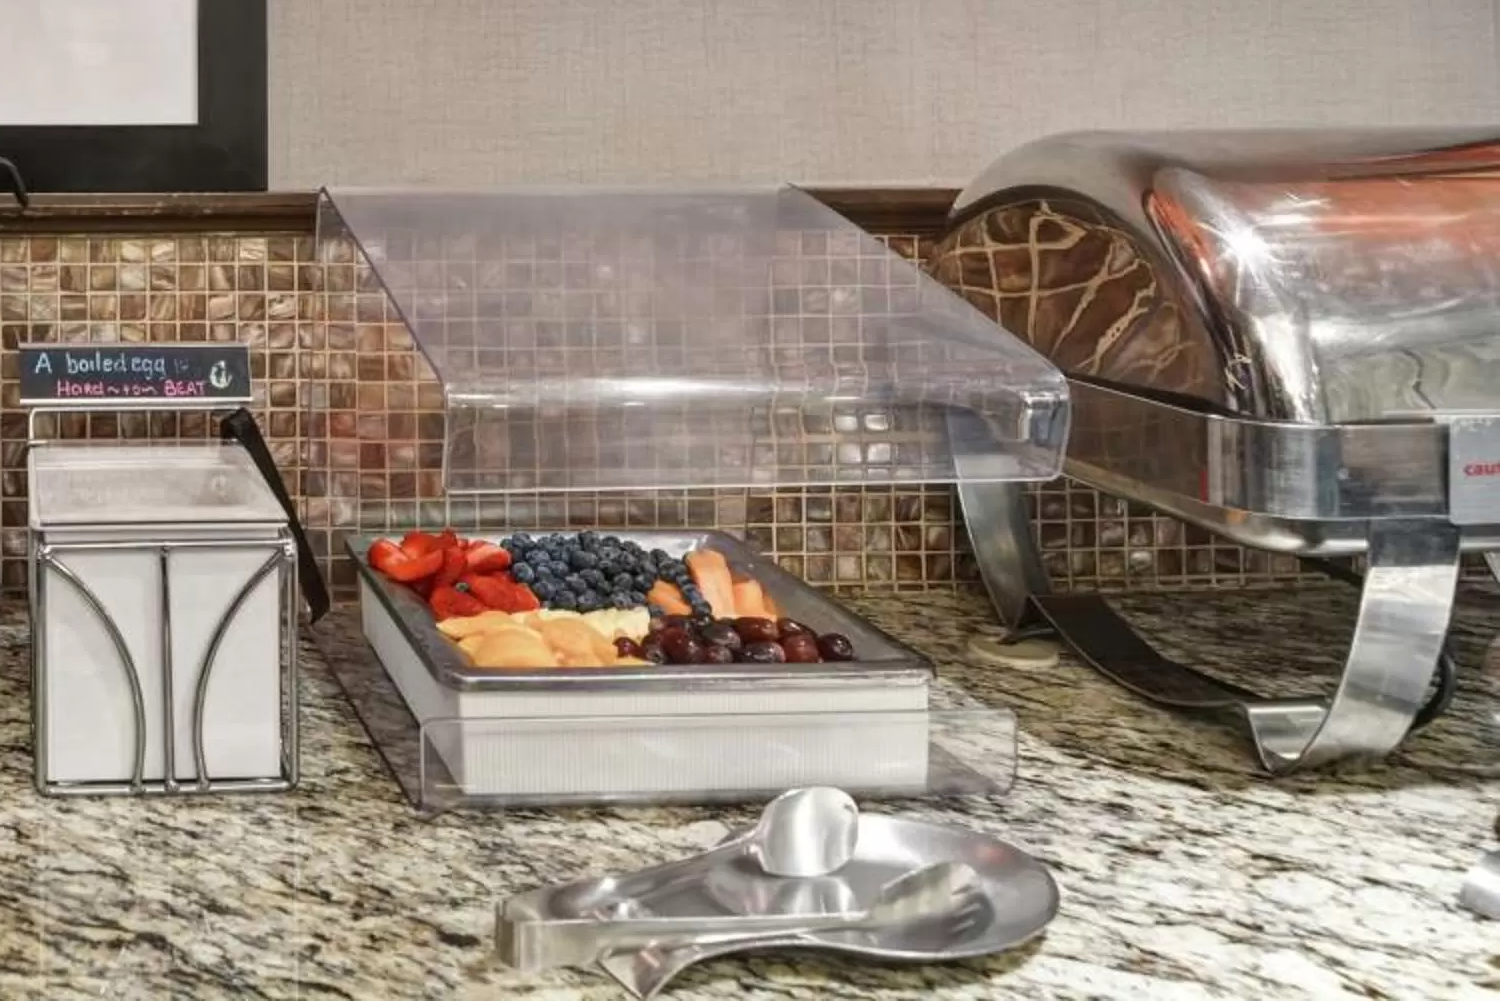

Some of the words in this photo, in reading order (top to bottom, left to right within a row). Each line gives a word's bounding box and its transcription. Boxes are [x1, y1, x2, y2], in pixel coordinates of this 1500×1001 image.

[35, 352, 52, 374] A
[65, 351, 127, 374] boiled
[131, 357, 165, 380] egg
[164, 380, 205, 396] BEAT
